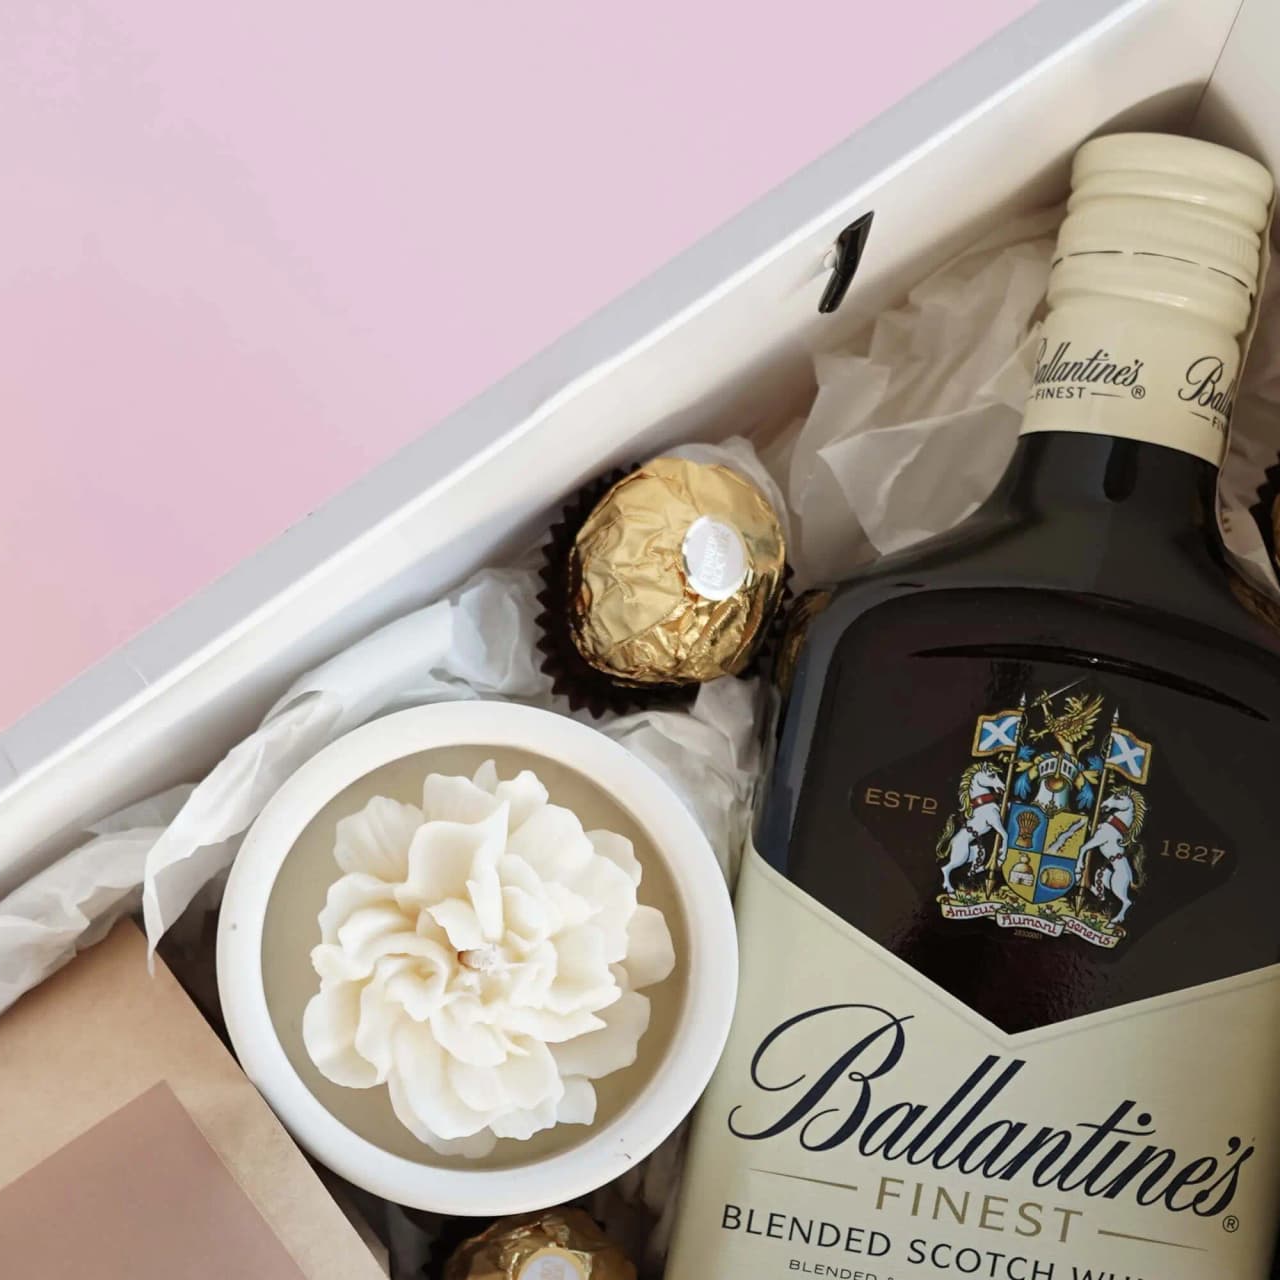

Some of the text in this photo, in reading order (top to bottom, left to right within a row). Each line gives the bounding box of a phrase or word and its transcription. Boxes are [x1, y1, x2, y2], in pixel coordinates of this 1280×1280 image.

[1035, 386, 1087, 401] FINEST
[1159, 839, 1227, 866] 1827
[945, 903, 996, 918] Amicus
[726, 1003, 1257, 1219] Ballantine's
[875, 1176, 1084, 1243] FINEST
[721, 1204, 891, 1257] BLENDED
